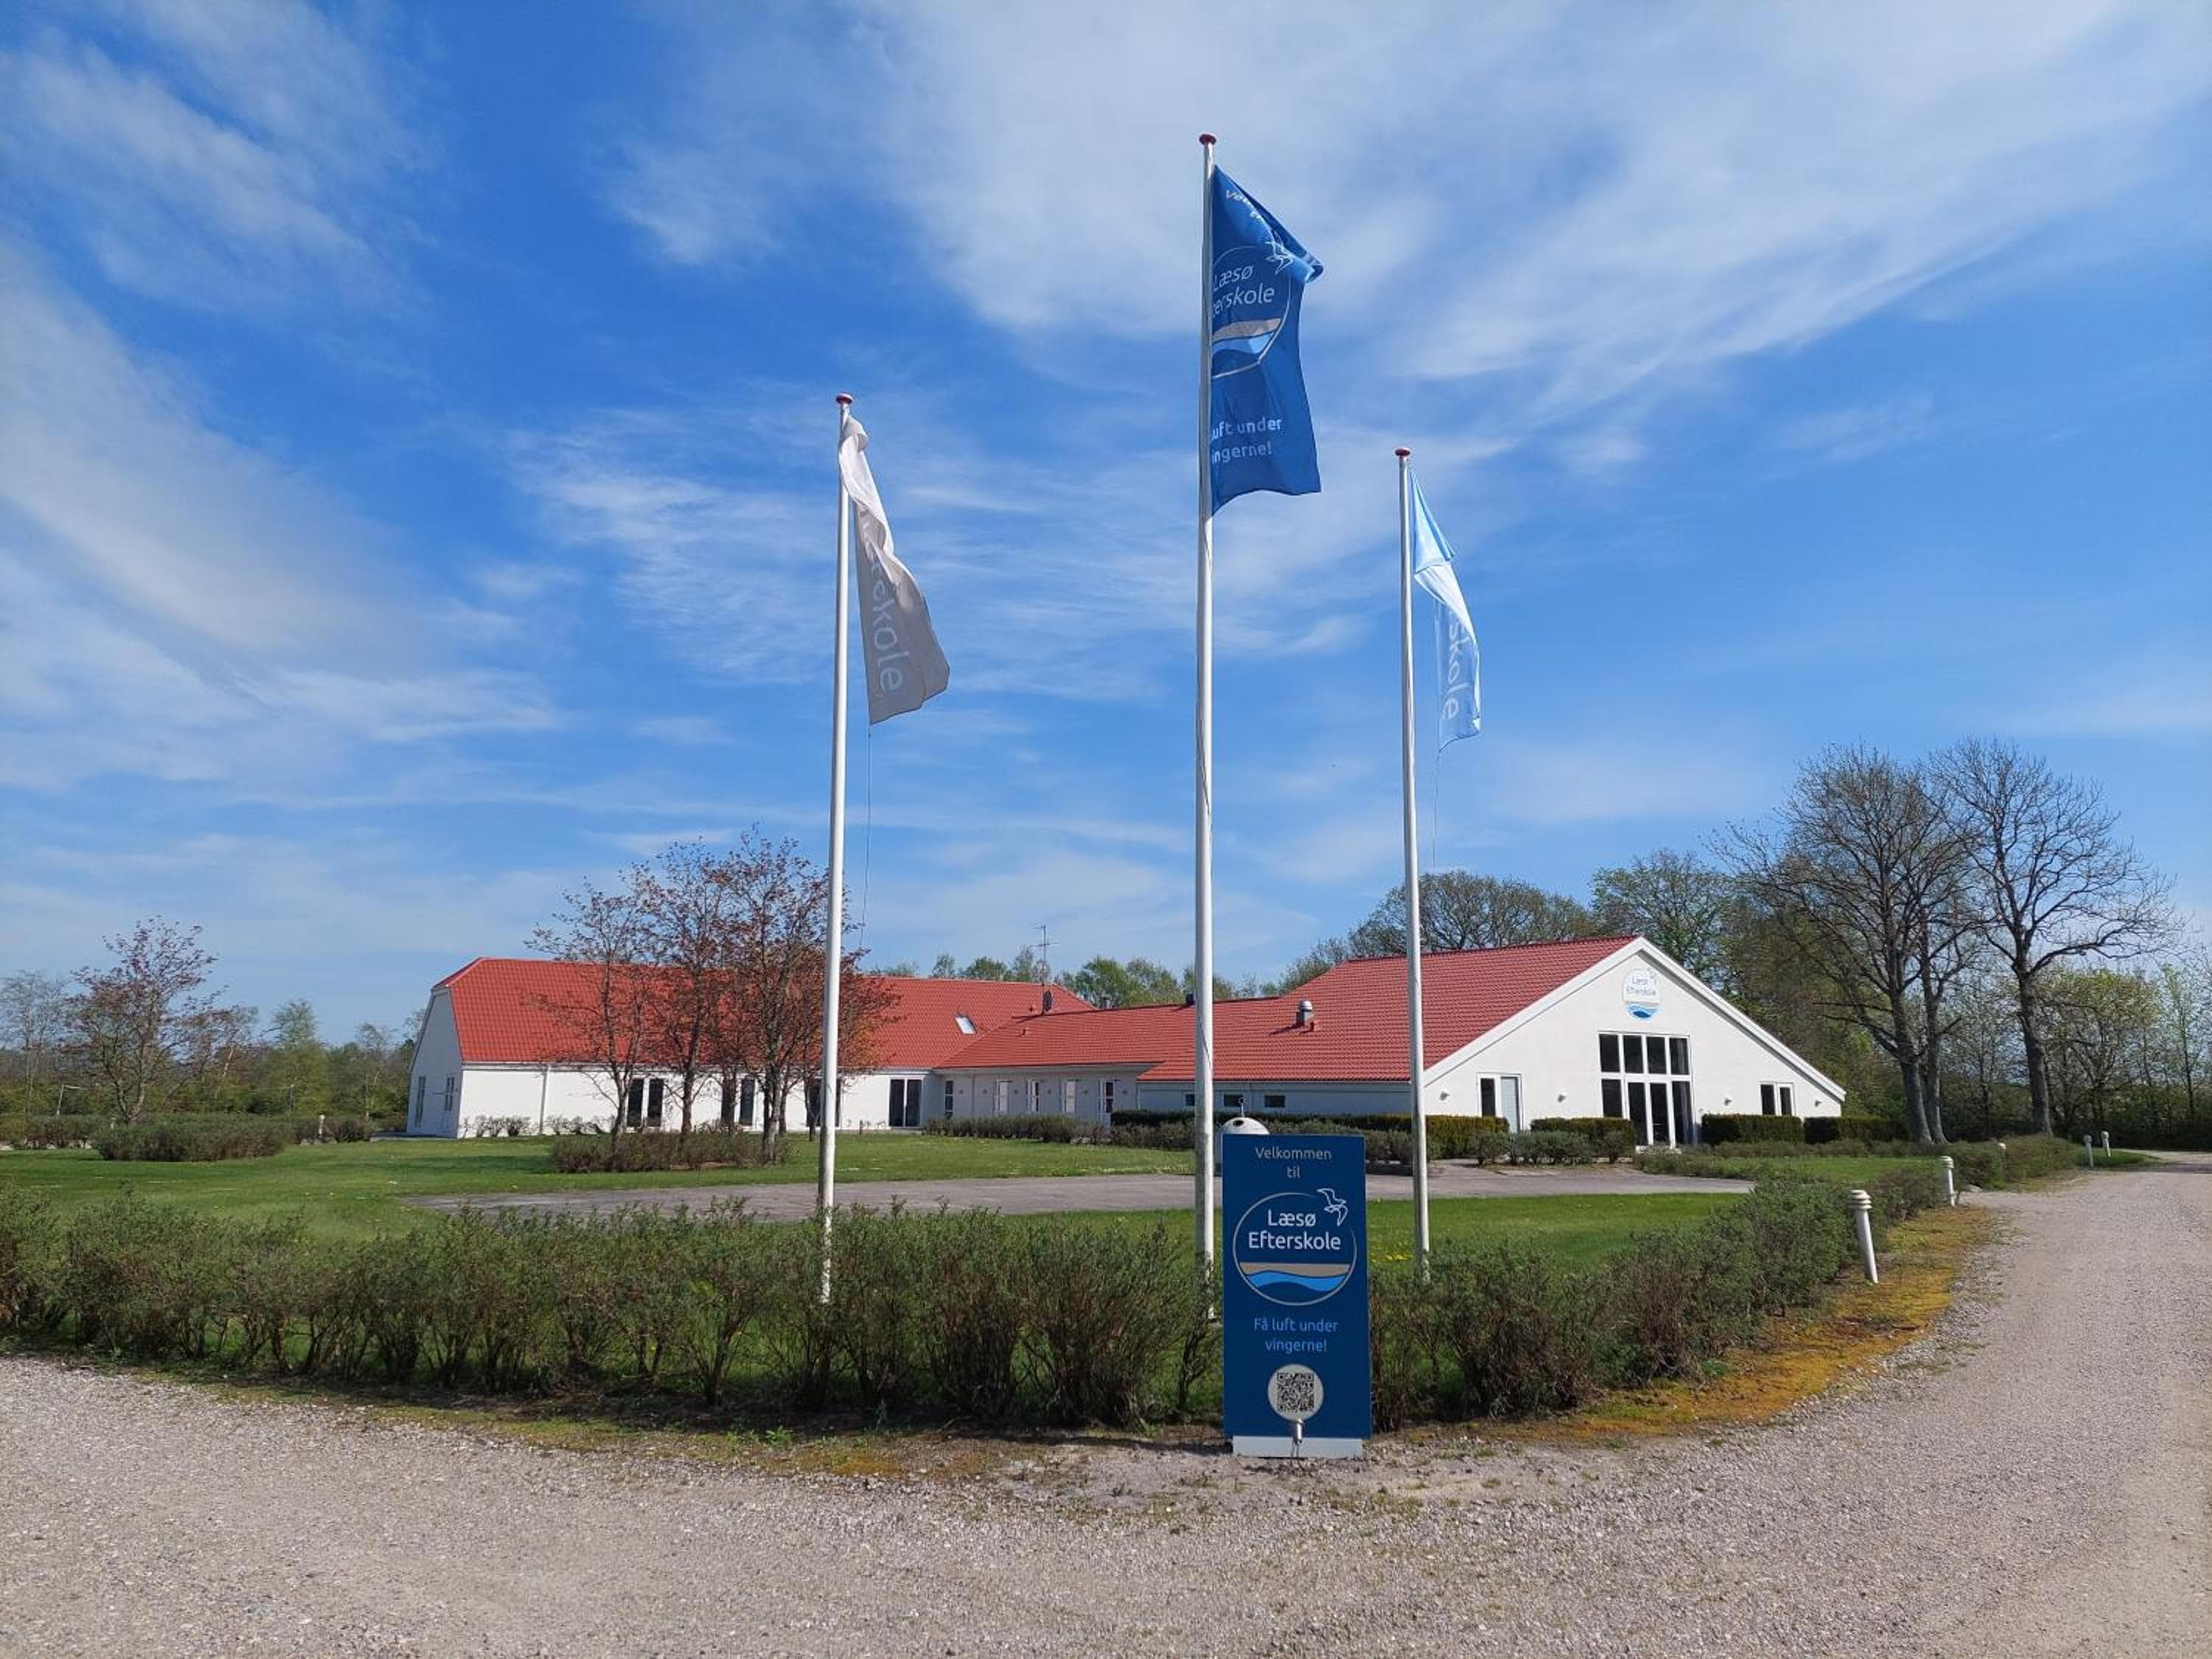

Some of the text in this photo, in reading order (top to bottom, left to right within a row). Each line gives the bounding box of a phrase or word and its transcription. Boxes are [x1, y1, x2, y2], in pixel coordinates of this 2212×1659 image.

[1213, 283, 1275, 317] erskole
[1211, 417, 1281, 441] uft under
[1255, 1147, 1332, 1160] Velkommen
[1287, 1166, 1301, 1178] til
[1267, 1209, 1316, 1227] Læsø
[1248, 1231, 1341, 1250] Efterskole
[1254, 1317, 1339, 1332] Få luft under
[1265, 1338, 1327, 1354] vingerne!
